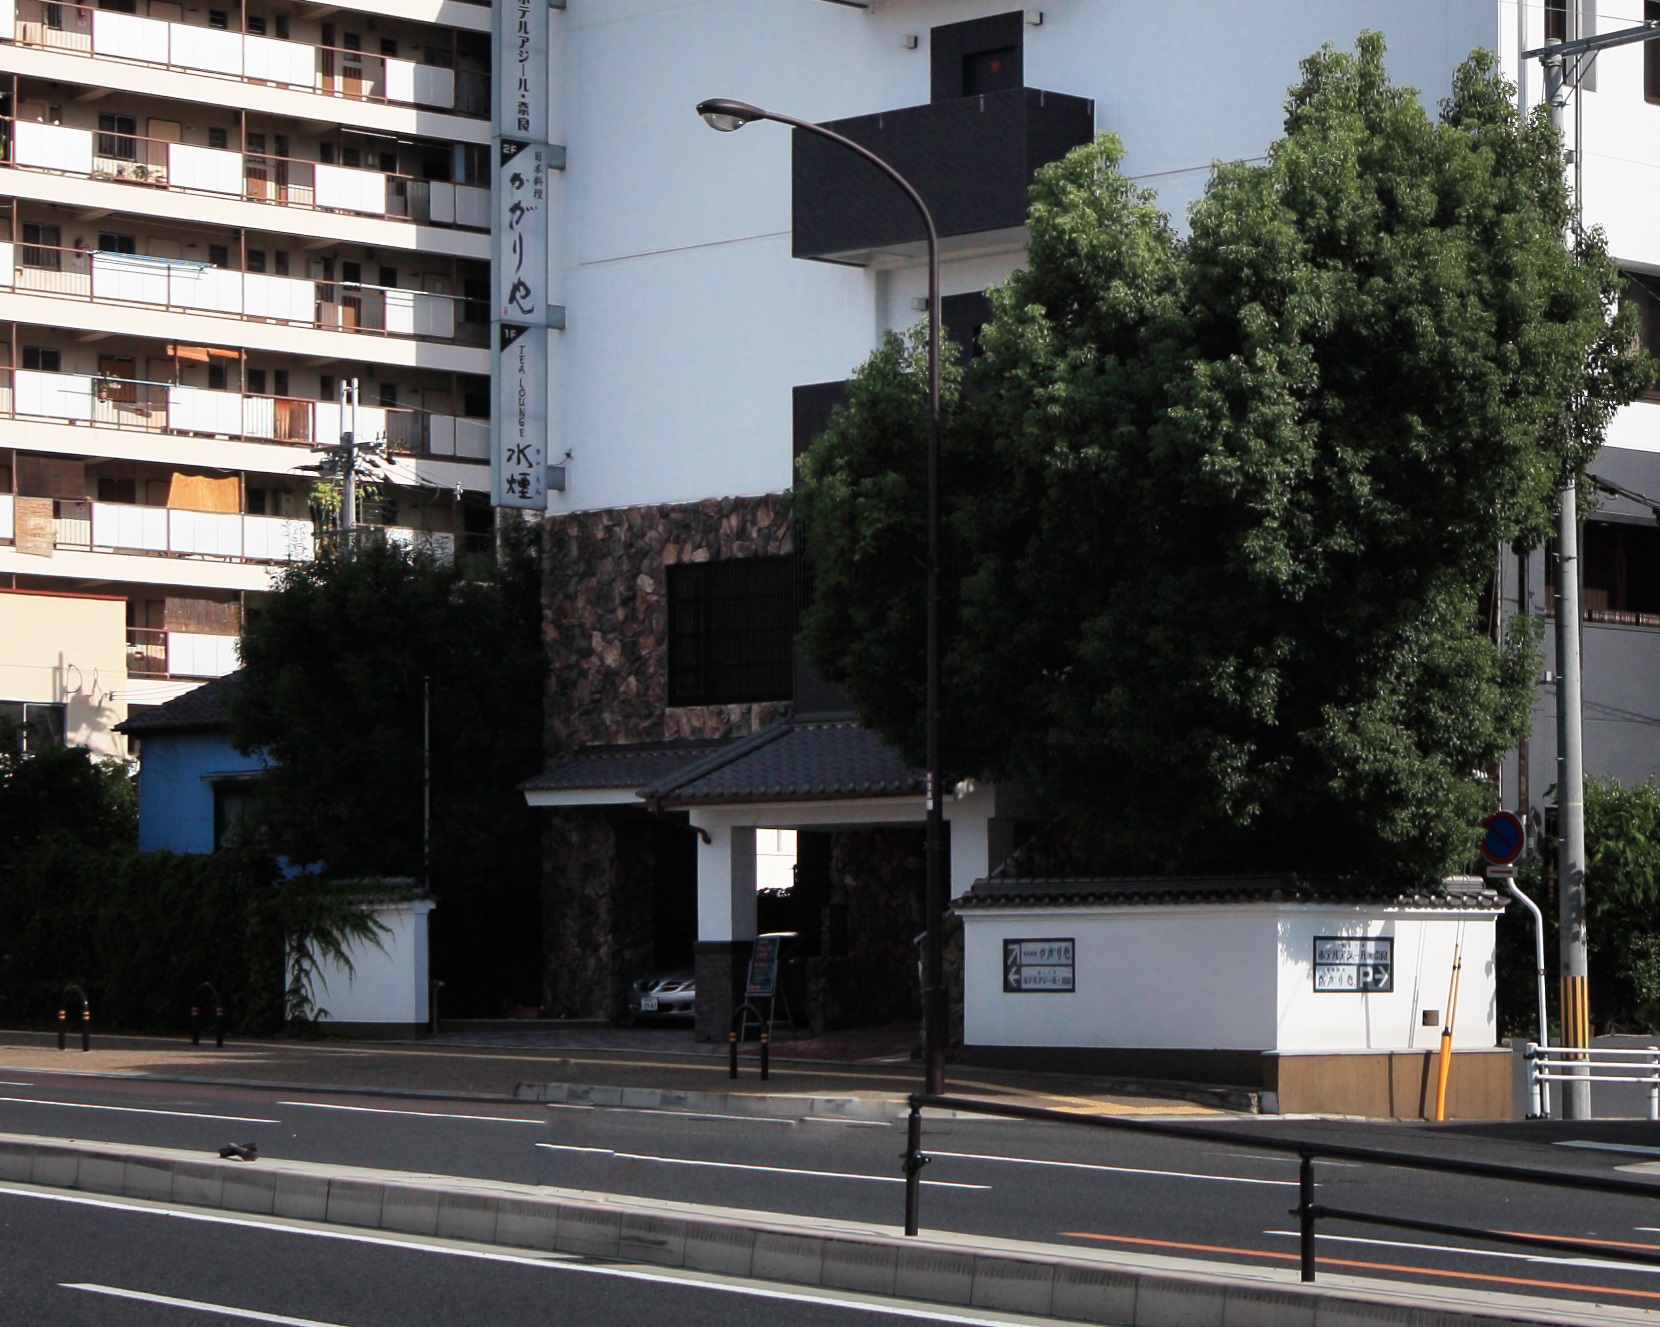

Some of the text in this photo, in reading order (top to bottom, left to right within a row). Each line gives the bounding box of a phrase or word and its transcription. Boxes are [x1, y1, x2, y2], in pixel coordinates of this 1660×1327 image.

[502, 144, 517, 154] 2F
[533, 151, 543, 200] 日本料理
[504, 328, 517, 339] 1F
[518, 345, 526, 438] TEA LOUNGE
[506, 443, 533, 500] 水煙
[1360, 966, 1374, 988] P
